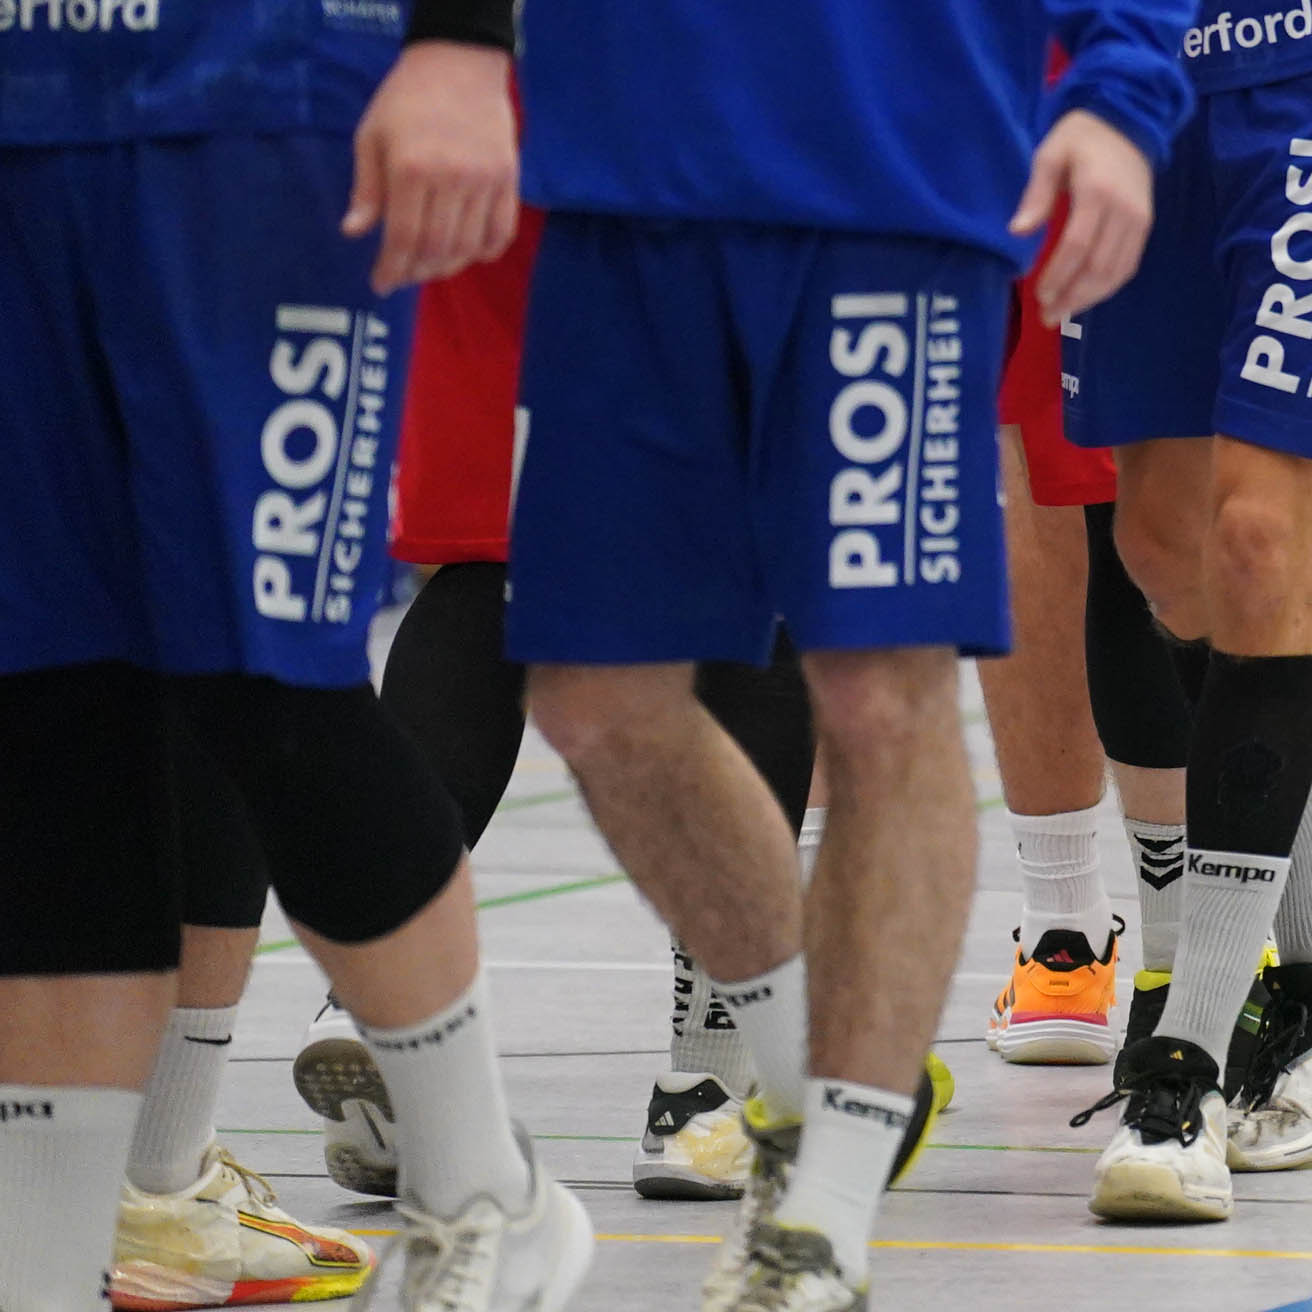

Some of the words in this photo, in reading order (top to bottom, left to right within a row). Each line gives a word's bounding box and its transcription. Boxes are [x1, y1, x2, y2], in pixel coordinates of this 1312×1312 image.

[252, 302, 352, 622] PROSI
[324, 312, 391, 625] SICHERHEIT
[829, 292, 909, 589] PROSI
[919, 292, 962, 584] SICHERHEIT
[1187, 853, 1276, 885] Kempa
